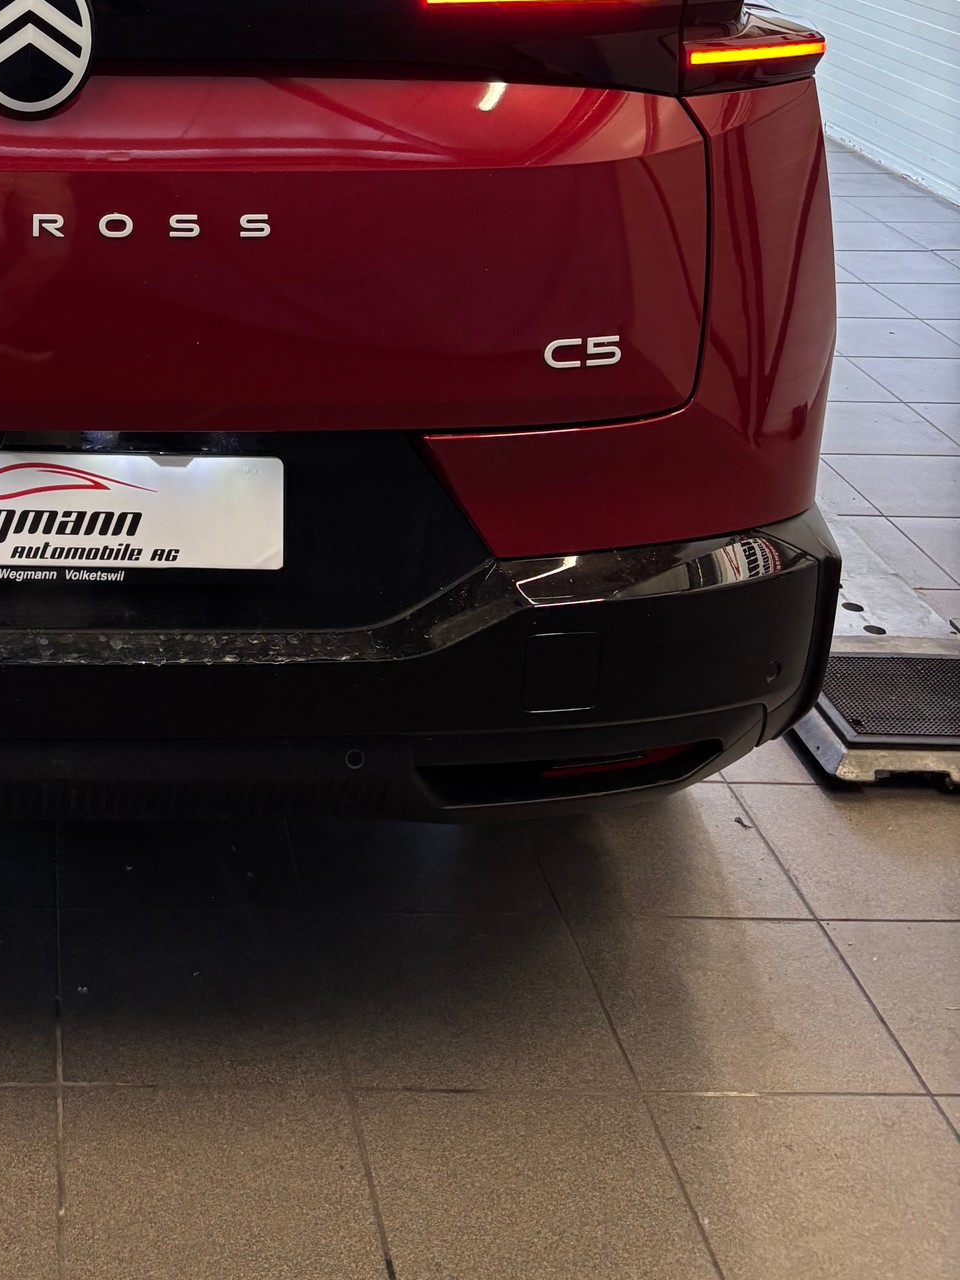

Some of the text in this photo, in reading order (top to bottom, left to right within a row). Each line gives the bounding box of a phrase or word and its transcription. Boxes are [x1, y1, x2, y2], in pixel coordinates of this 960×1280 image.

[544, 335, 621, 369] C5
[149, 548, 180, 562] AG
[65, 569, 125, 582] Volketswil
